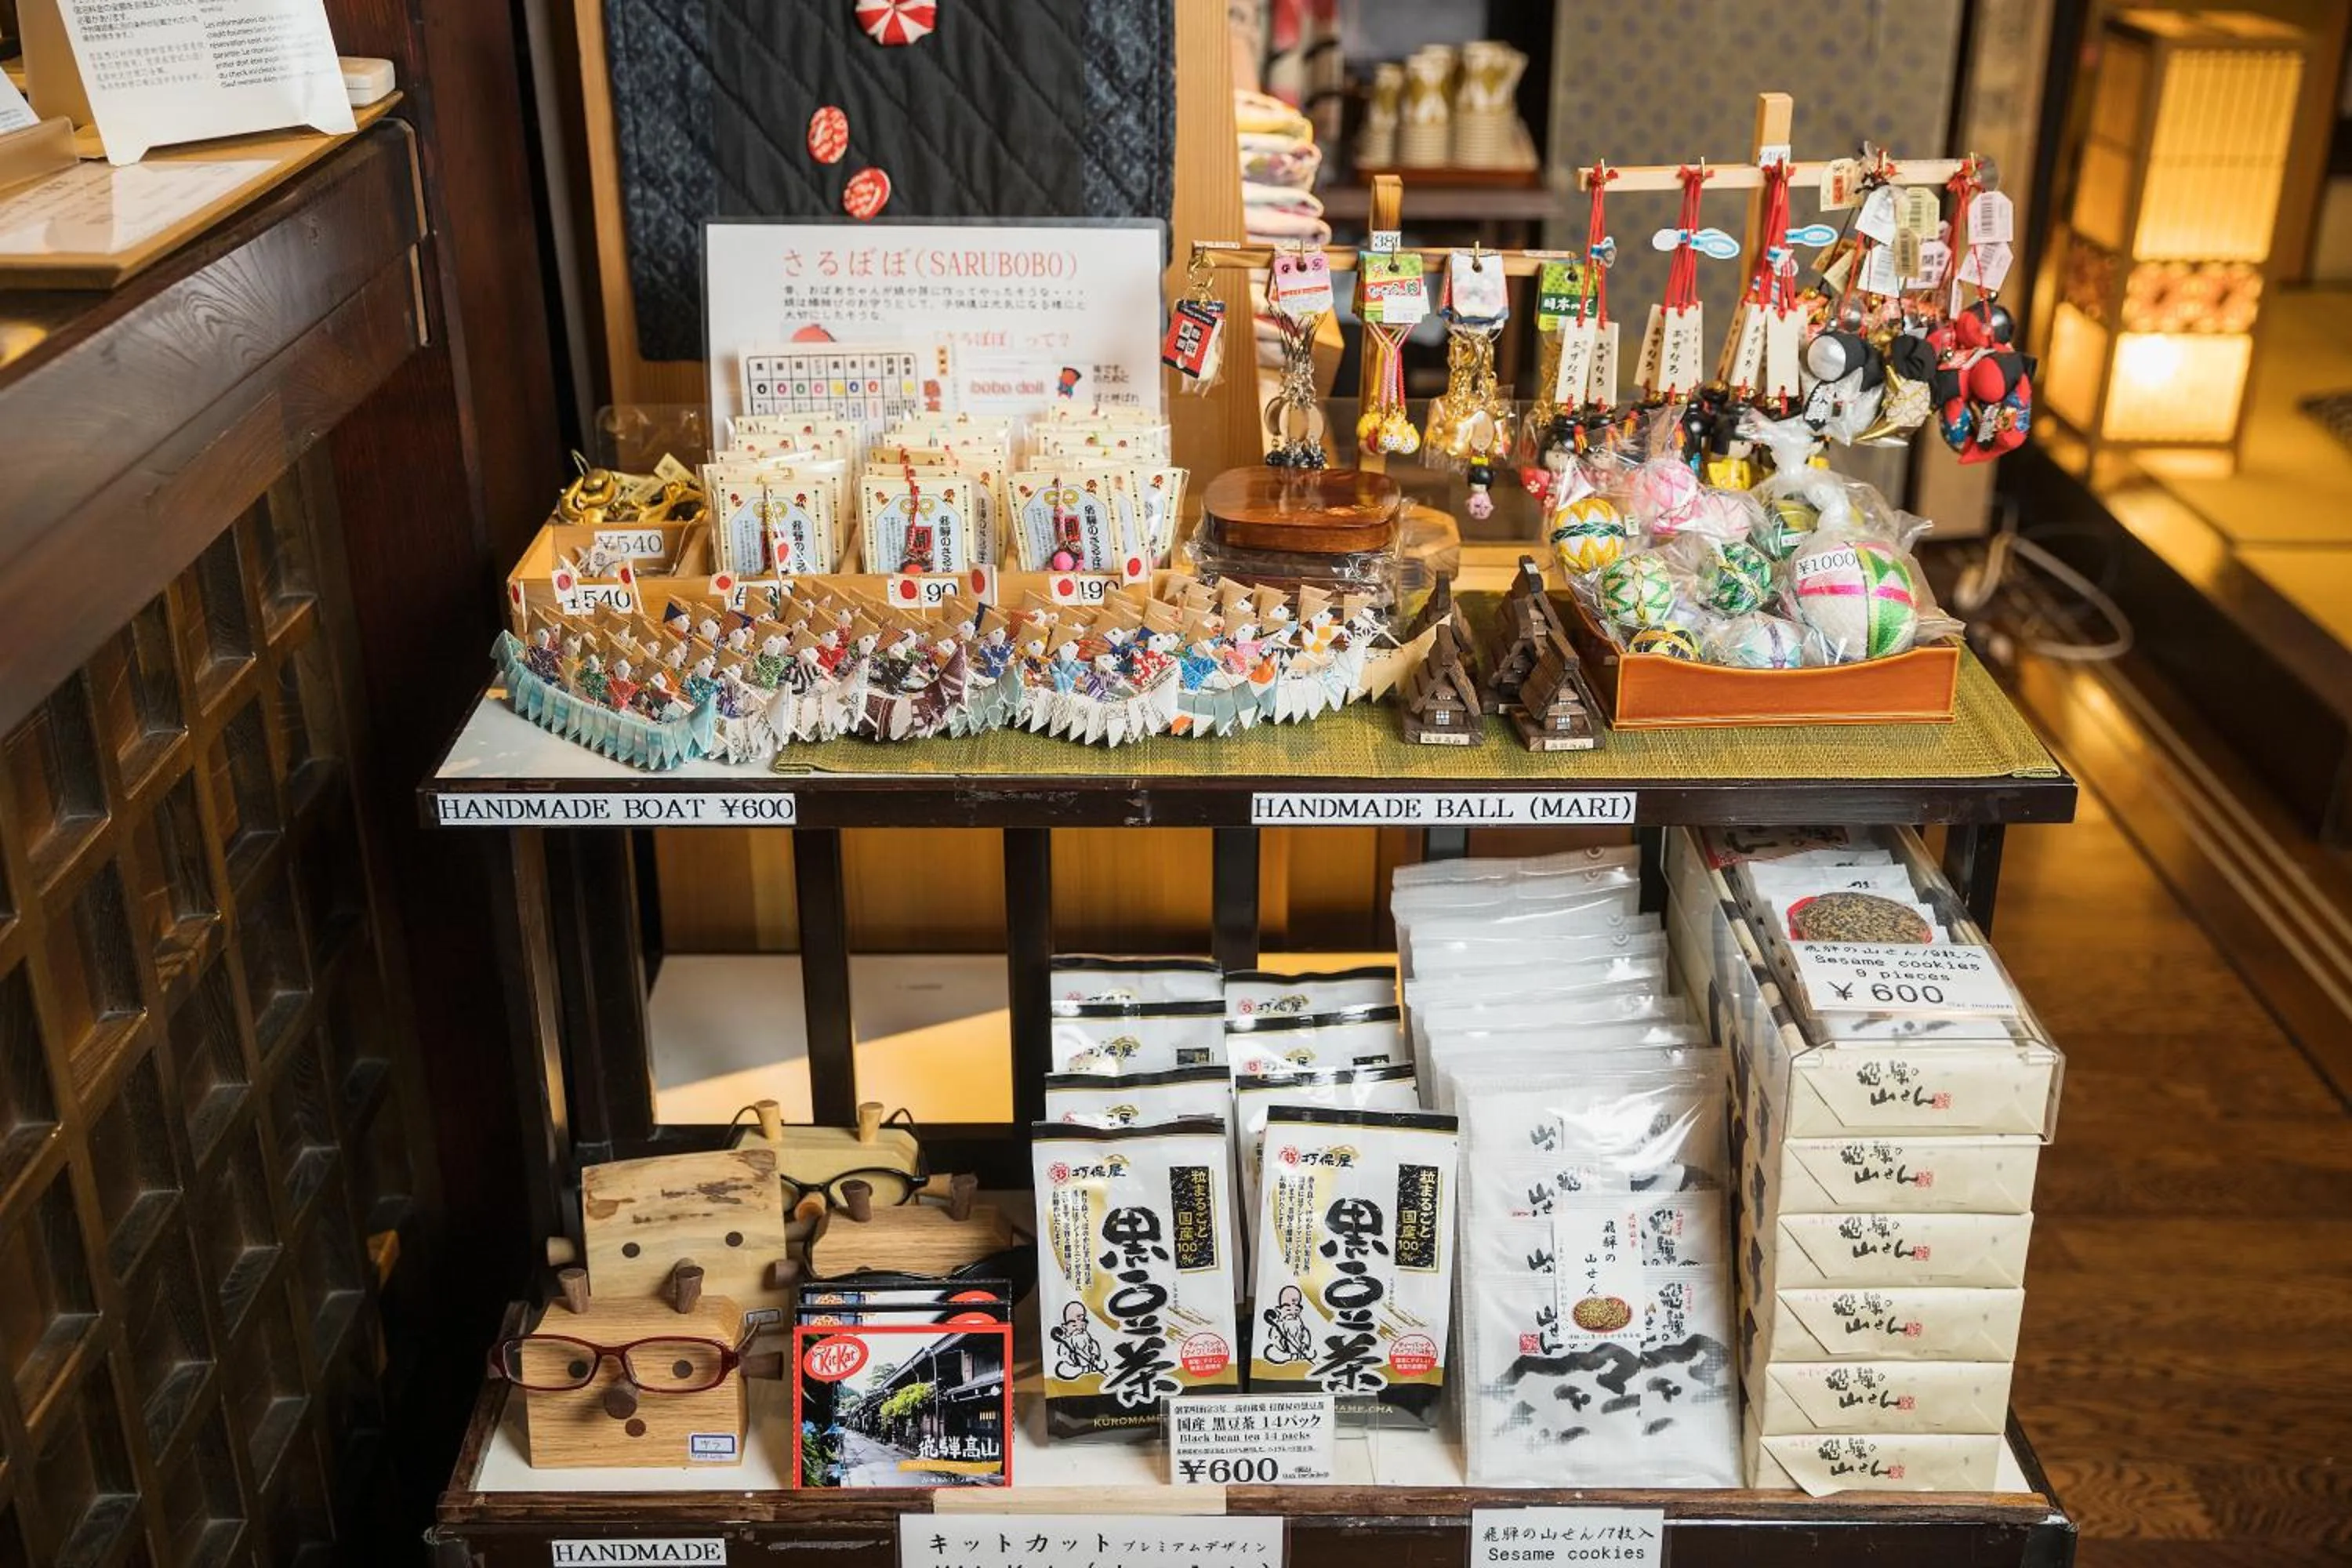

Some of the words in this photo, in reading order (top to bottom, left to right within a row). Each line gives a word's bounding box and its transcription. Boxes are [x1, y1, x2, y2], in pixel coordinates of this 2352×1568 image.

[784, 247, 1078, 280] さるぼぼ(SARUBOBO)
[1798, 552, 1856, 575] ¥1000
[440, 798, 610, 818] HANDMADE
[624, 798, 706, 818] BOAT
[720, 798, 795, 818] ¥600
[1254, 797, 1421, 818] HANDMADE
[1435, 797, 1515, 818] BALL
[1529, 796, 1632, 820] (MARI)
[1814, 954, 1885, 967] Sesame
[1898, 960, 1980, 971] cookies
[1856, 968, 1867, 978] 9
[1879, 971, 1951, 982] pieces
[1191, 1171, 1208, 1238] 粒まるごと
[1419, 1170, 1436, 1238] 粒まるごと
[1099, 1207, 1177, 1399] 黒豆茶
[1311, 1199, 1388, 1391] 黒豆茶
[1177, 1417, 1205, 1432] 国産
[1212, 1416, 1254, 1431] 黒豆茶
[1263, 1414, 1322, 1428] 14パック
[919, 1435, 1000, 1459] 飛騨高山
[1180, 1433, 1210, 1443] Black
[1214, 1433, 1240, 1443] bean
[1244, 1433, 1260, 1442] tea
[1265, 1432, 1277, 1440] 14
[1282, 1431, 1311, 1442] packs
[1178, 1458, 1279, 1483] ¥600
[929, 1533, 1109, 1554] キットカット
[1123, 1540, 1268, 1553] プレミアムデザイン
[1483, 1526, 1655, 1541] 飛騨の山せん/7枚入
[554, 1543, 720, 1562] HANDMADE
[1489, 1548, 1555, 1561] Sesame
[1567, 1547, 1644, 1561] cookies
